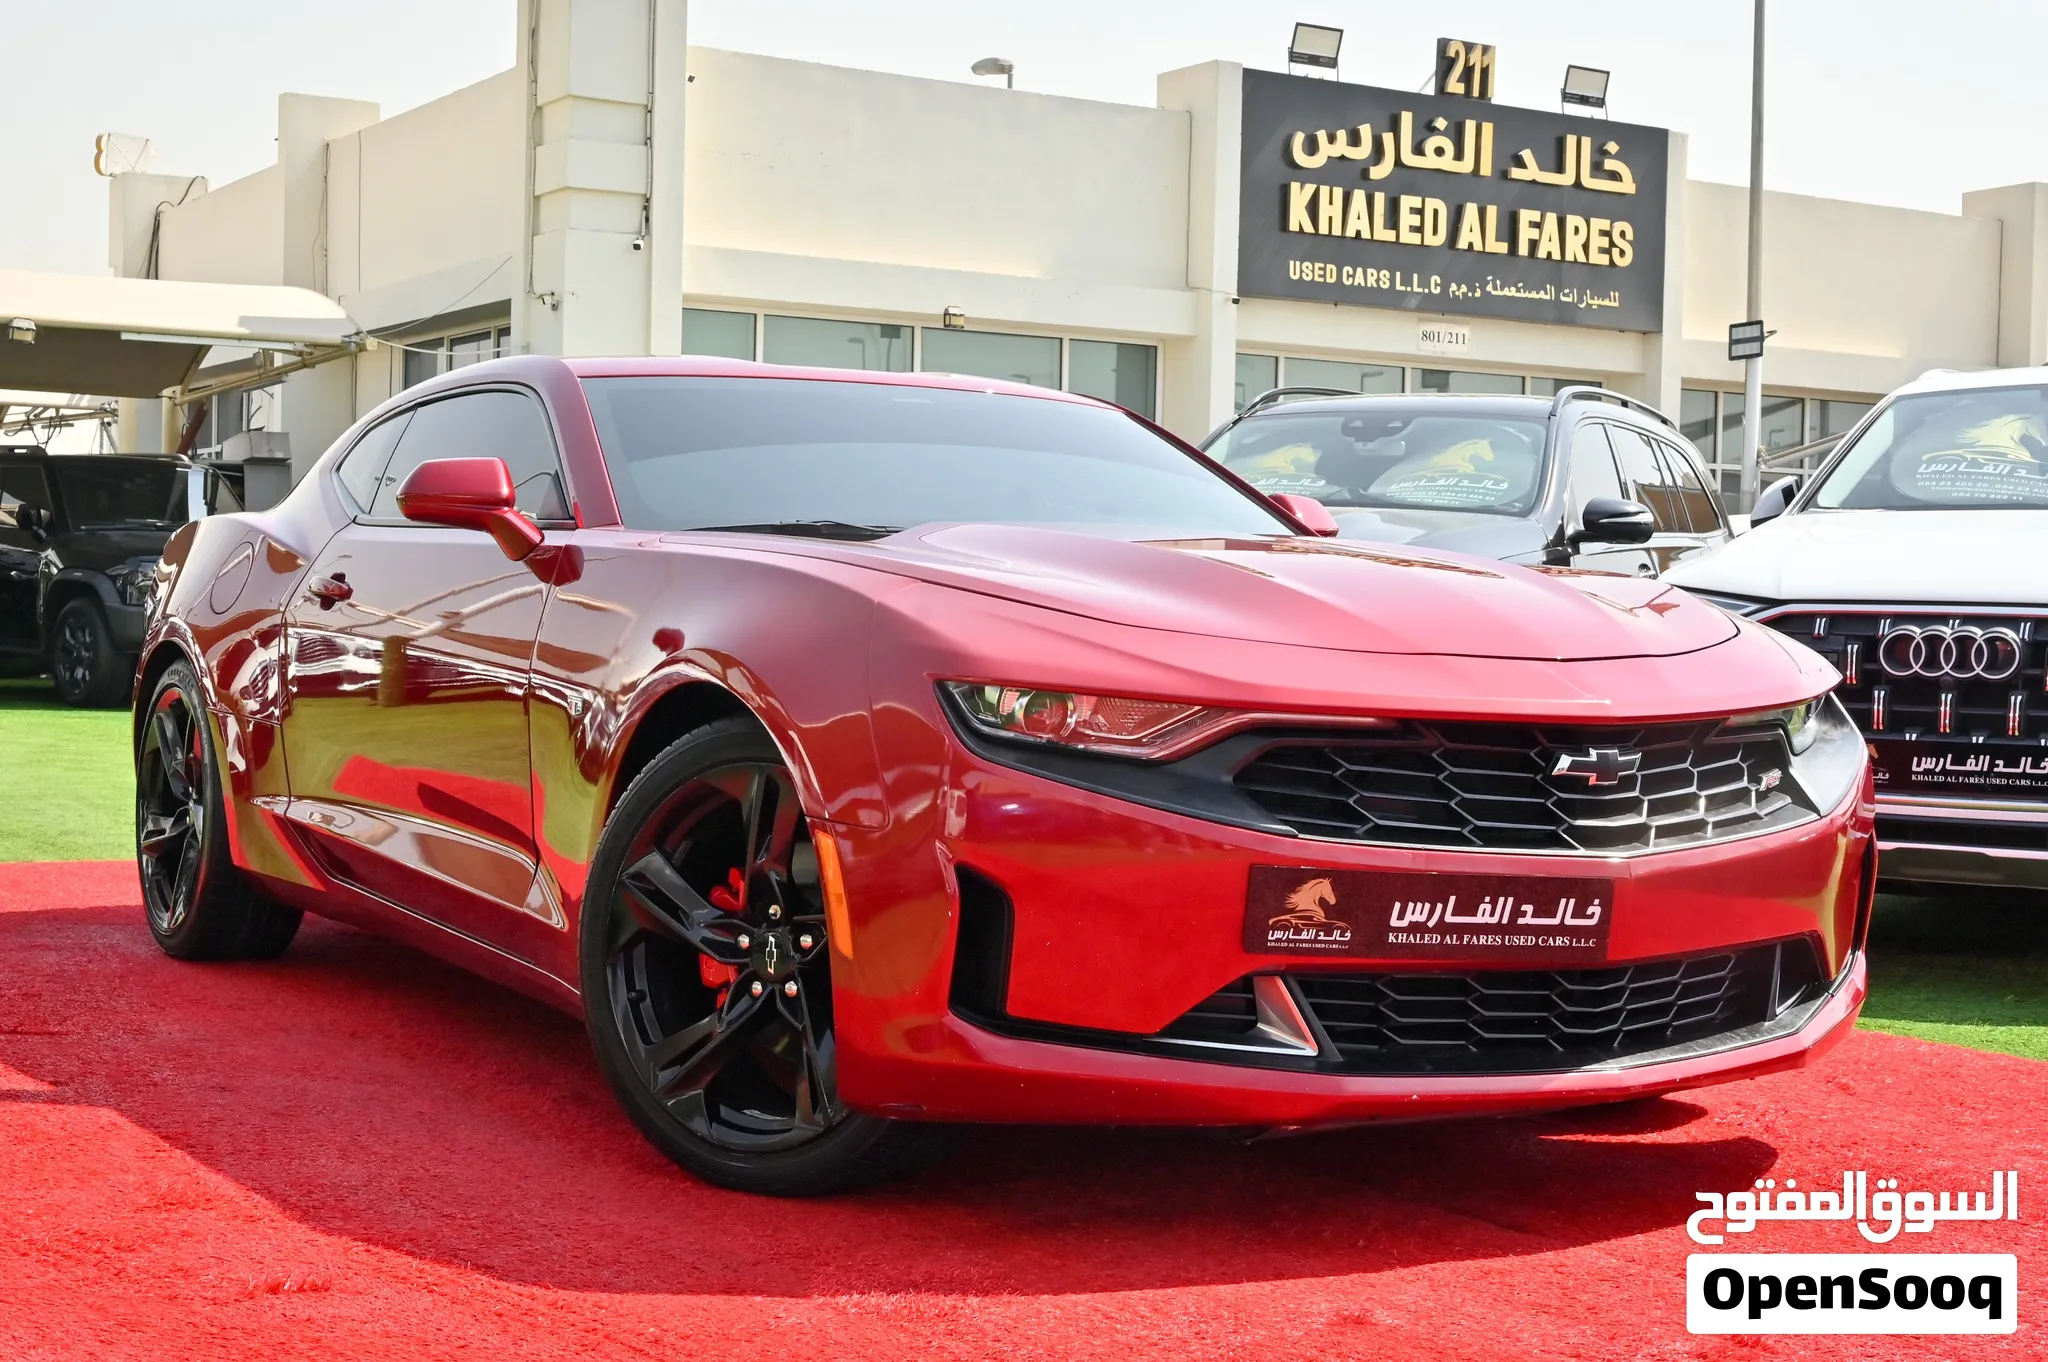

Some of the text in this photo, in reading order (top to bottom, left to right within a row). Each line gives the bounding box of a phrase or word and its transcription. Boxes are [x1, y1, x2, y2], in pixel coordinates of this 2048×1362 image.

[1444, 40, 1496, 98] 211
[1291, 111, 1636, 194] خالد الفارس
[1288, 181, 1634, 267] KHALED AL FARES
[1289, 260, 1441, 294] USED CARS L.L.C
[1485, 275, 1555, 301] المستعملة
[1559, 288, 1620, 309] للسيارات
[1421, 330, 1467, 345] 801/211
[1912, 754, 2048, 774] خالد الفارس
[1911, 774, 1945, 782] KHALED
[1959, 776, 1985, 784] FARES
[1389, 895, 1601, 928] خالد الفارس
[1268, 928, 1351, 940] خالد الفارس
[1388, 932, 1597, 947] KHALED AL FARES USED CARS L.L.C
